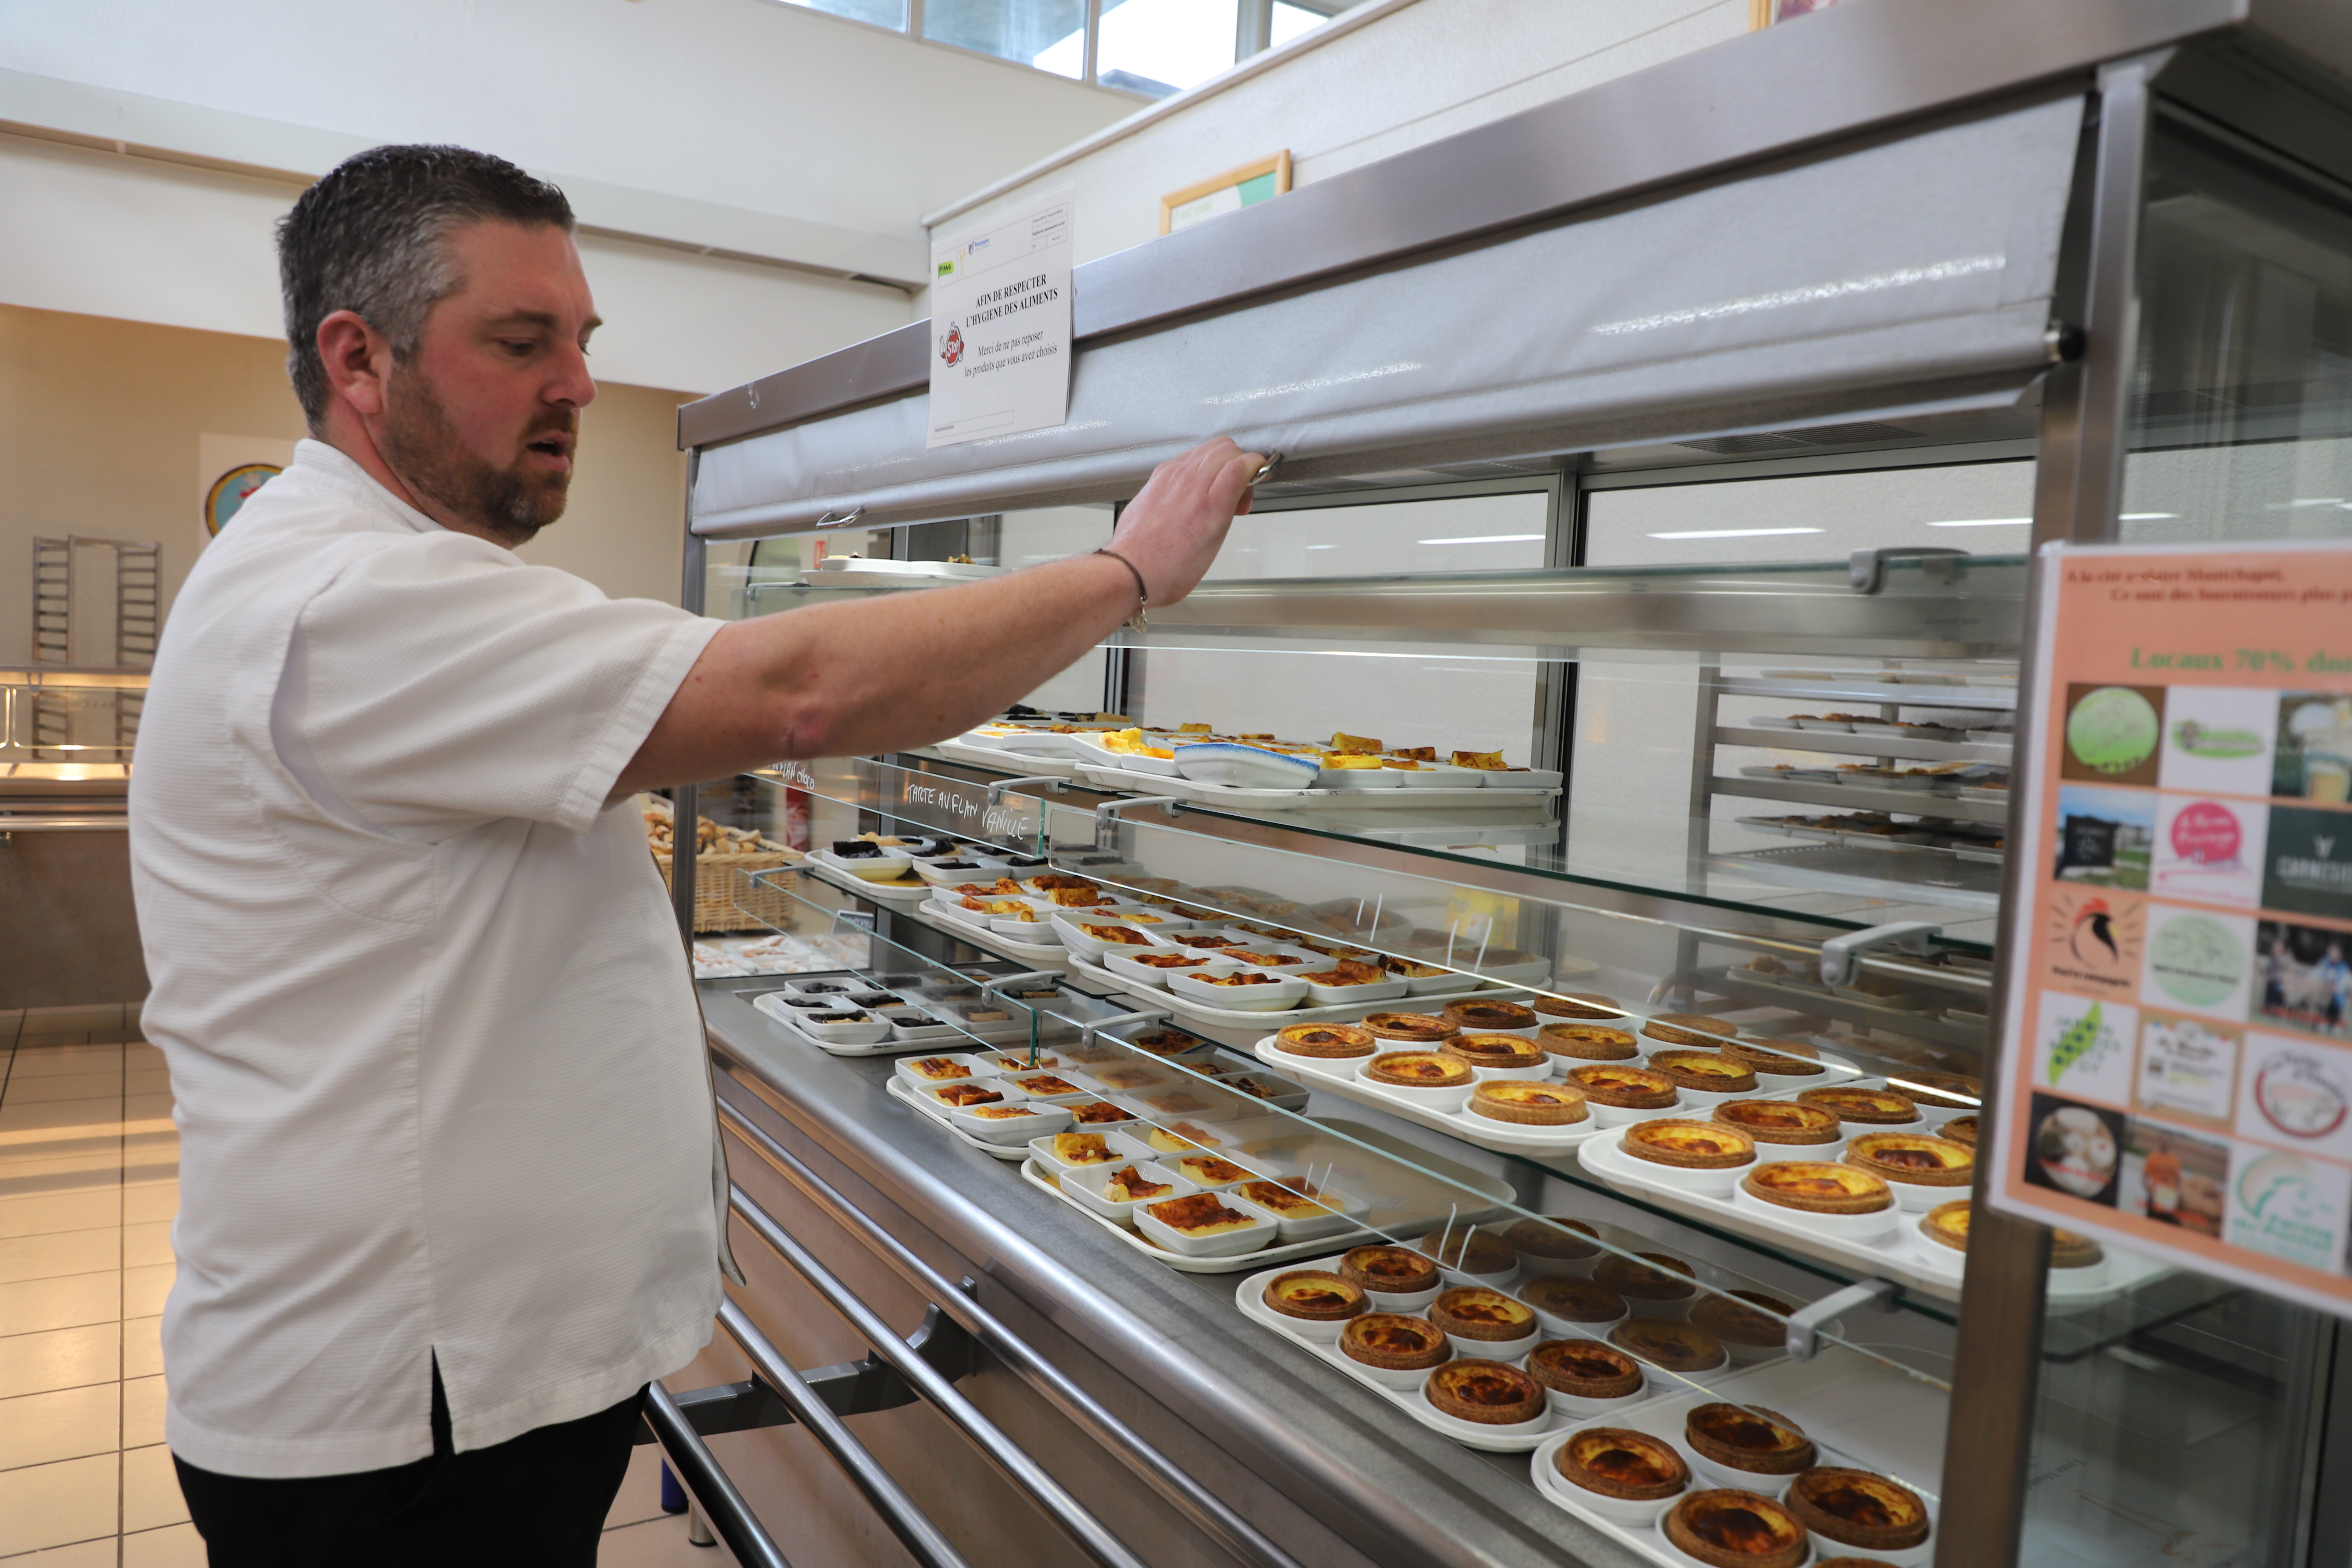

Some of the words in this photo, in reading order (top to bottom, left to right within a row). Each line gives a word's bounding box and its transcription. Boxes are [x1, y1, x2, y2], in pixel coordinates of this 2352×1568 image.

[939, 264, 952, 272] PMS
[976, 293, 992, 308] AFIN
[993, 289, 1003, 302] DE
[1004, 274, 1047, 298] RESPECTER
[966, 306, 1003, 328] L'HYGIENE
[1004, 301, 1018, 315] DES
[1019, 288, 1058, 311] ALIMENTS
[947, 339, 959, 358] STOP
[978, 342, 994, 357] Merci
[995, 341, 1001, 352] de
[1003, 340, 1010, 350] ne
[1011, 338, 1021, 351] pas
[1022, 331, 1043, 346] reposer
[973, 360, 995, 378] produits
[996, 359, 1006, 371] que
[1007, 354, 1020, 365] vous
[1021, 350, 1035, 362] avez
[1037, 342, 1058, 358] choisis
[2170, 588, 2193, 601] des
[2130, 647, 2223, 670] Locaux
[2235, 648, 2296, 672] 70%
[908, 784, 936, 804] TARTE
[951, 794, 978, 819] FLAN
